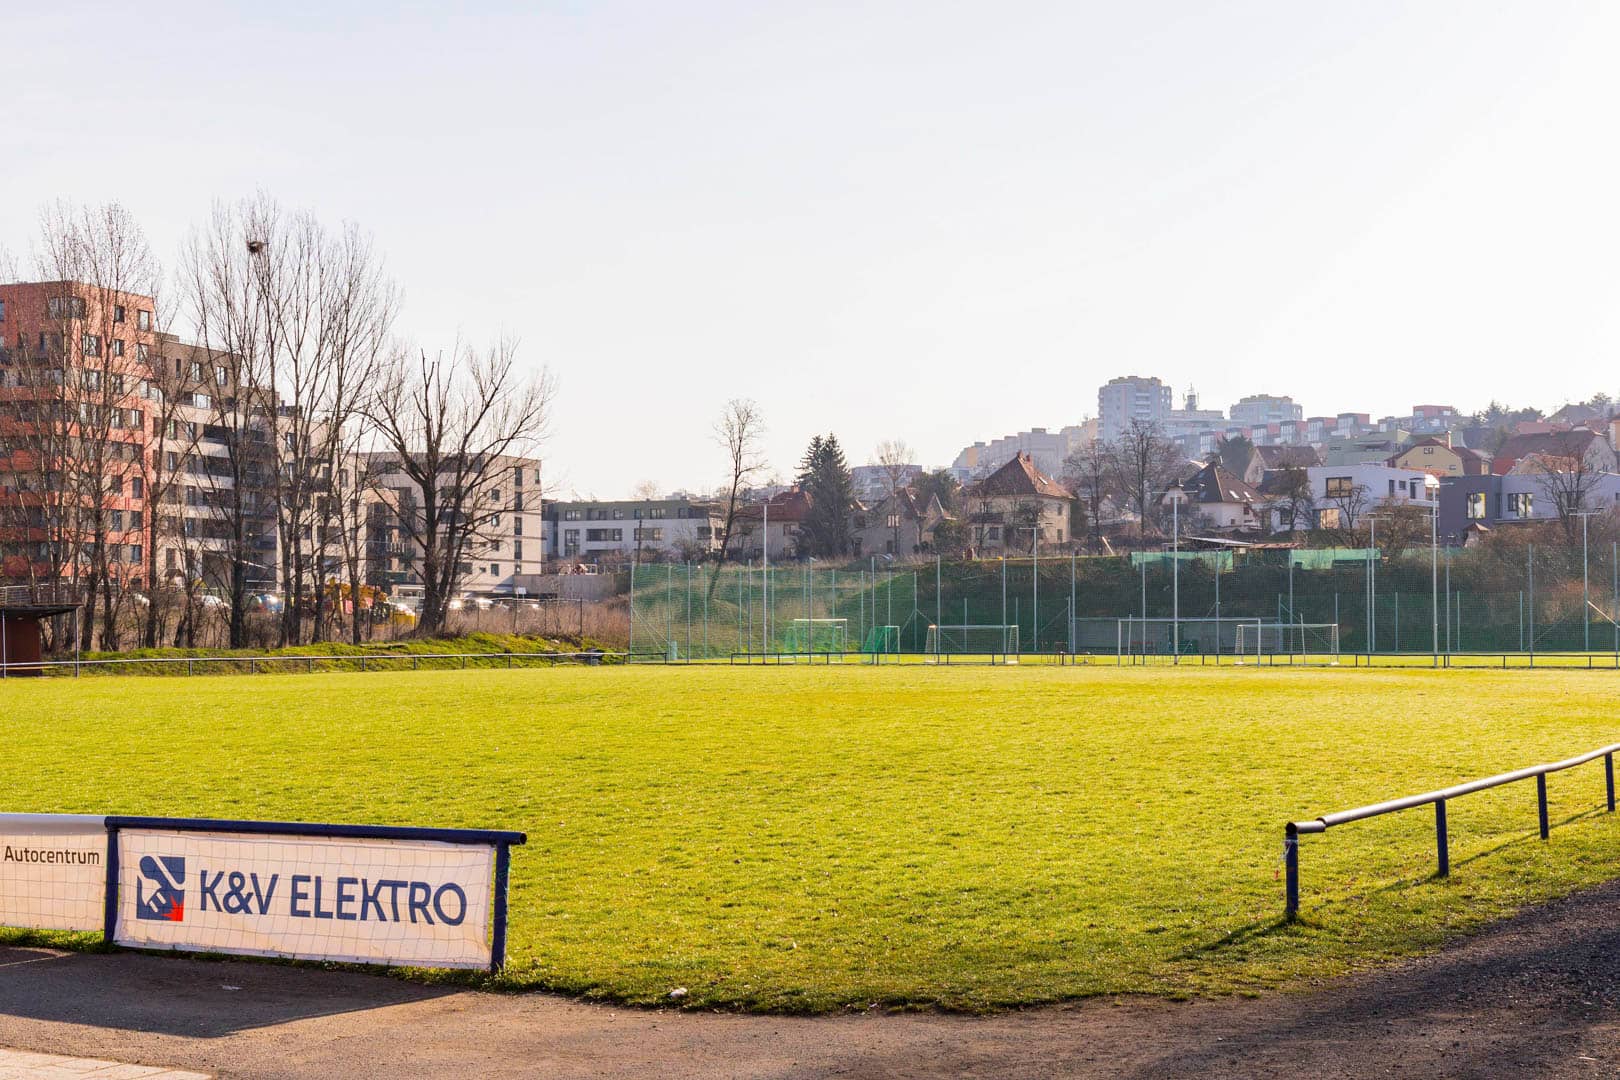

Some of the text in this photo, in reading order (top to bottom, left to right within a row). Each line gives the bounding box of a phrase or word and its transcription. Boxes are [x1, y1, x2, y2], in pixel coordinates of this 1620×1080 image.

[3, 845, 100, 866] Autocentrum
[200, 869, 468, 926] K&V ELEKTRO
